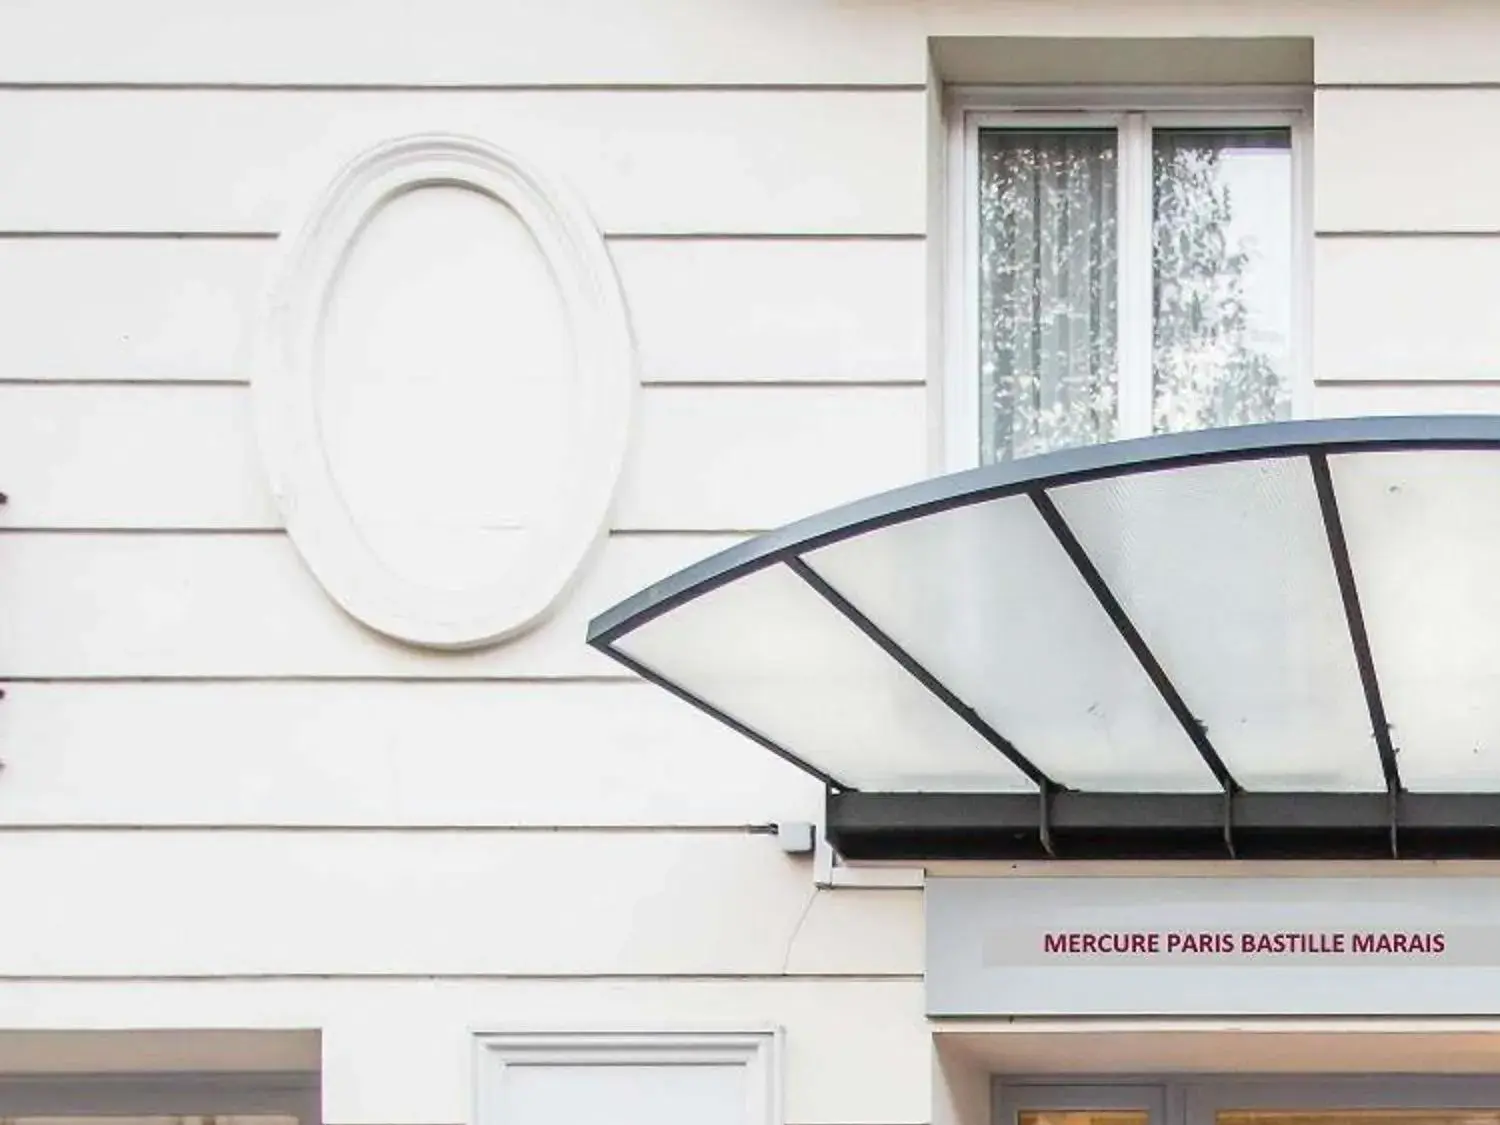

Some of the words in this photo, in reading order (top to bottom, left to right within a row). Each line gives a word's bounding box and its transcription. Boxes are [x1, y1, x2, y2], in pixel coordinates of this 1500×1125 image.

[1044, 933, 1160, 953] MERCURE
[1167, 933, 1235, 953] PARIS
[1241, 933, 1345, 953] BASTILLE
[1352, 933, 1446, 953] MARAIS
